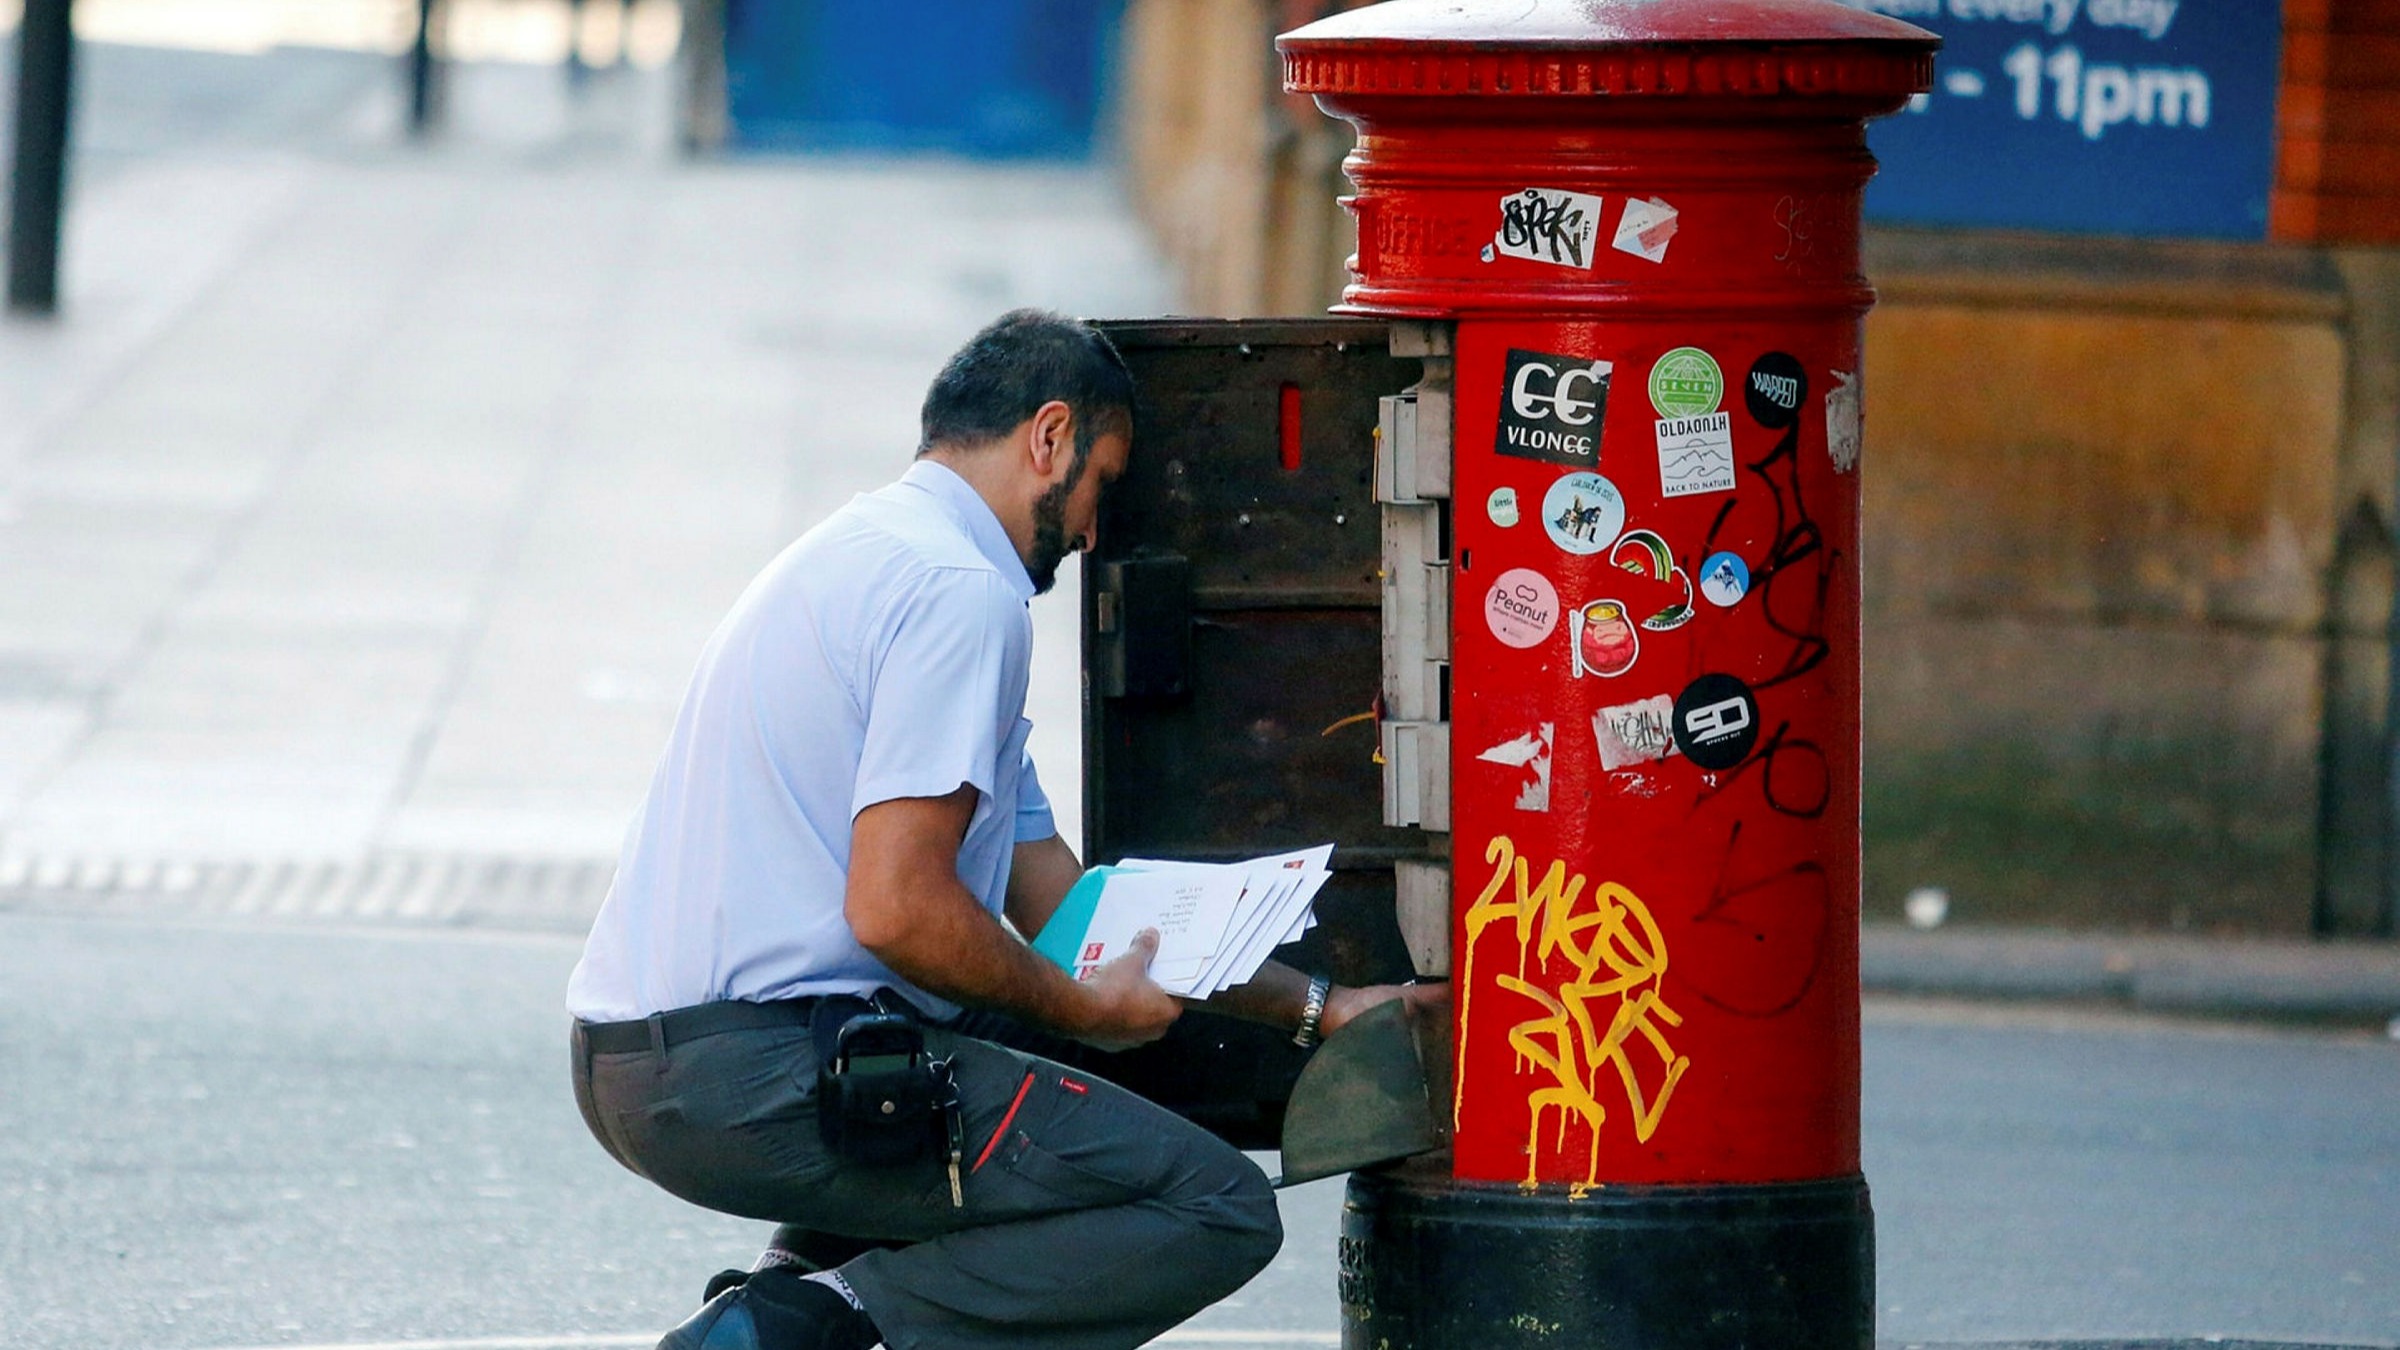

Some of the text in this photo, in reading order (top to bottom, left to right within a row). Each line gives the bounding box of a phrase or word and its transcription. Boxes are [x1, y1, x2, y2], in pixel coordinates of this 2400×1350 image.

[2003, 42, 2209, 139] 11pm
[1660, 380, 1712, 392] SEVEN
[1752, 371, 1797, 408] WARPED
[1665, 478, 1731, 494] BACK TO NATURE
[1494, 589, 1548, 625] Peanut
